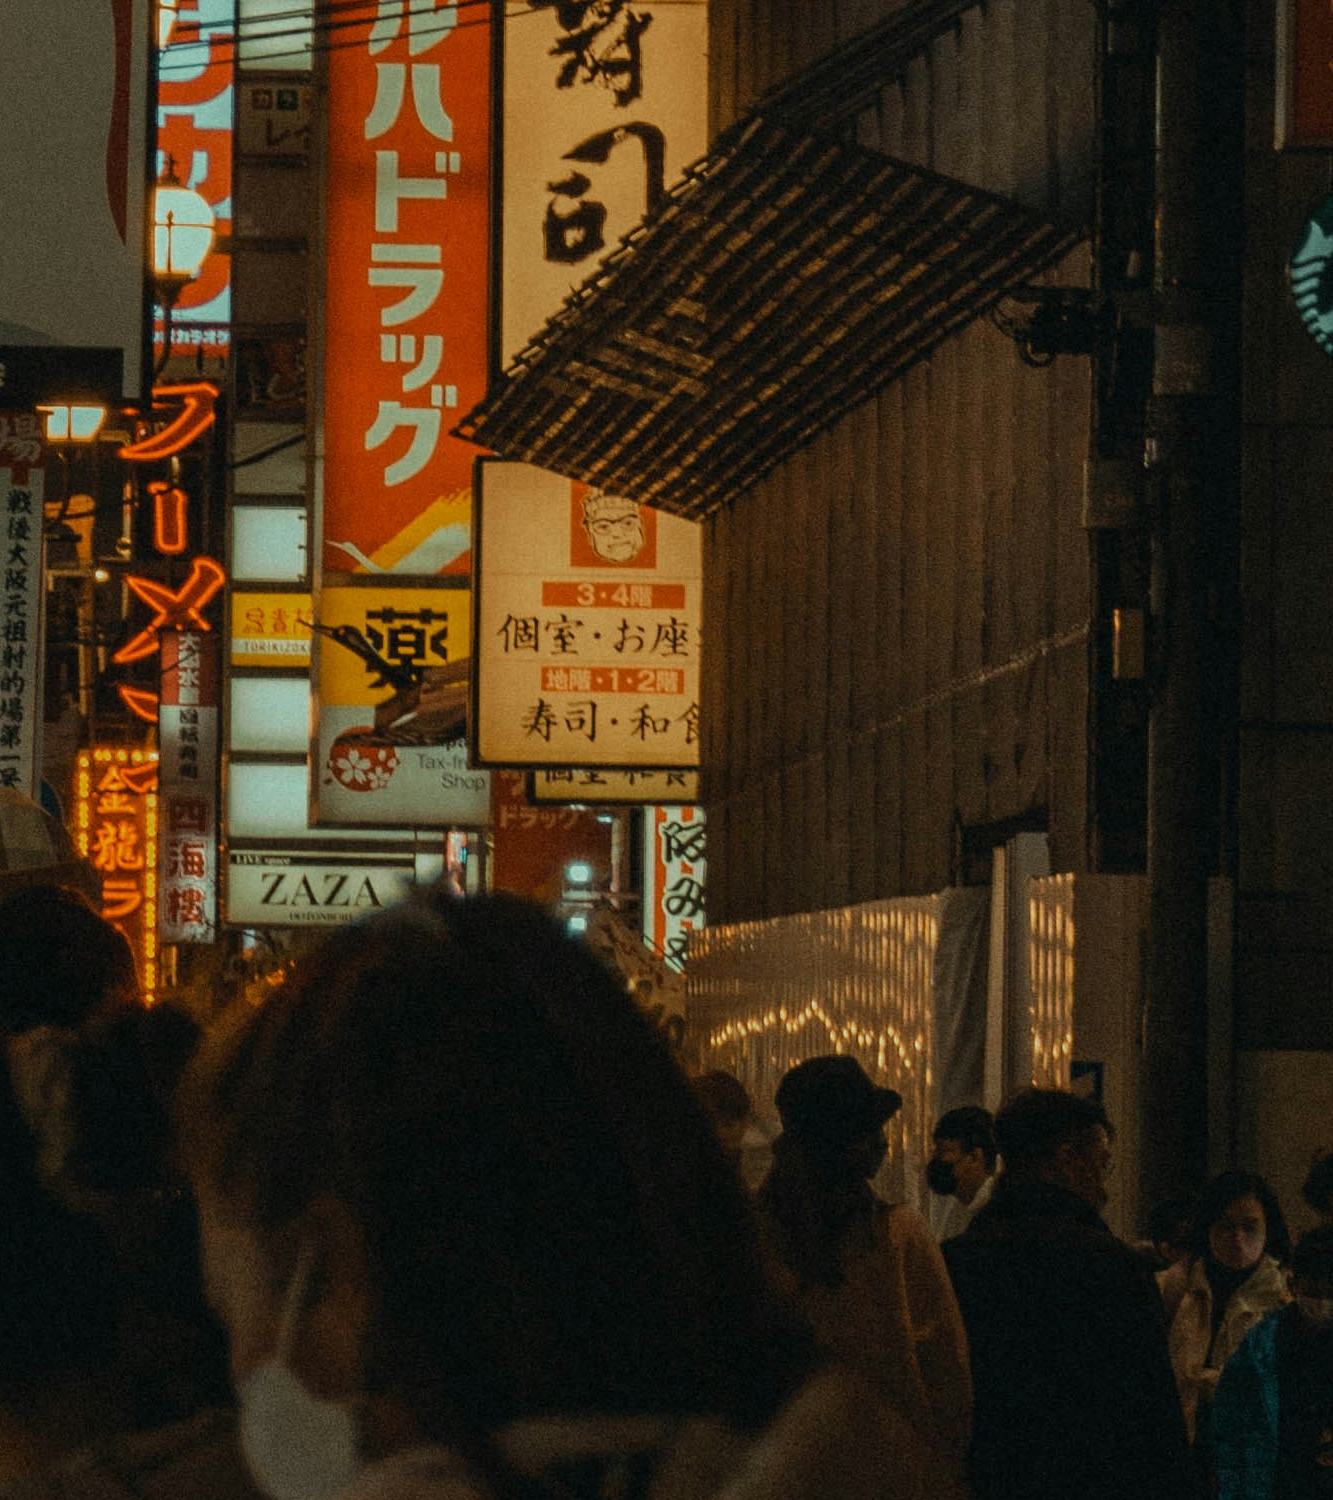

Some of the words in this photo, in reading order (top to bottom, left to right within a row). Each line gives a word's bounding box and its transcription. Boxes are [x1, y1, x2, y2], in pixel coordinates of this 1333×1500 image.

[497, 613, 701, 658] 個室・お座
[417, 753, 468, 770] Tax-fr
[441, 774, 486, 791] Shop
[260, 872, 383, 908] ZAZA
